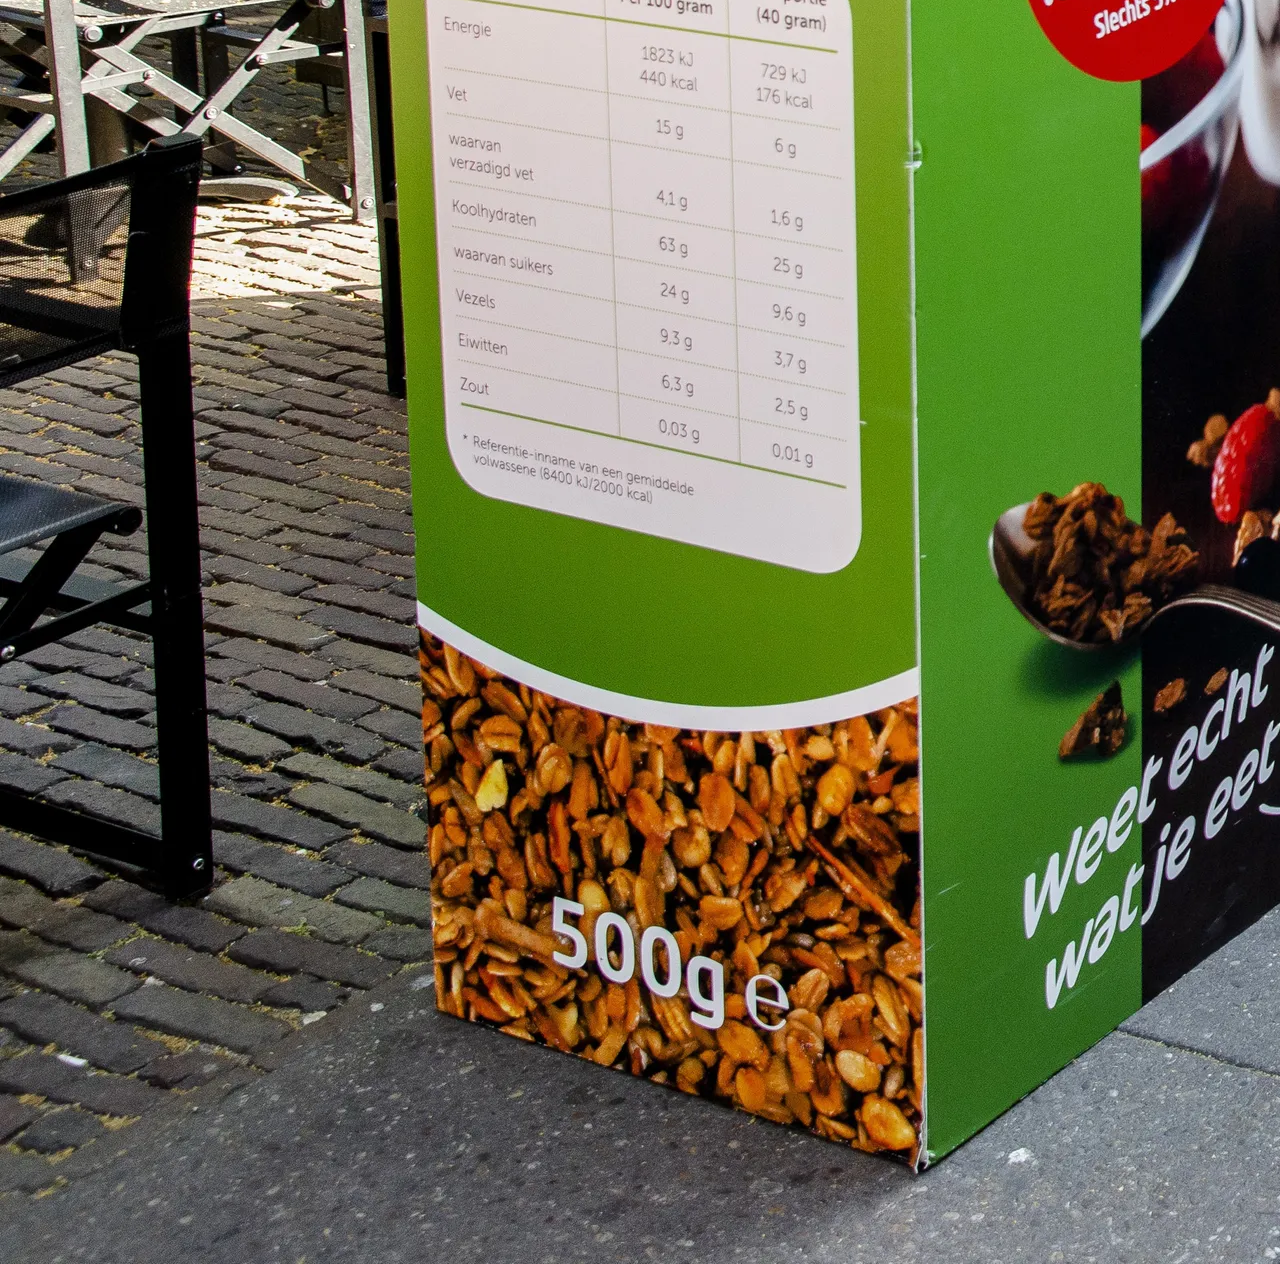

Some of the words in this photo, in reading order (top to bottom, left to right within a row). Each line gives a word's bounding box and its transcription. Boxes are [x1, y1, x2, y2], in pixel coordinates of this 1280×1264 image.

[444, 17, 492, 38] Energie
[756, 7, 780, 26] (40
[784, 12, 827, 33] gram)
[641, 46, 675, 65] 1823
[677, 50, 694, 67] kJ
[639, 70, 667, 87] 440
[670, 74, 698, 92] kcal
[760, 63, 787, 81] 729
[791, 67, 807, 85] kJ
[446, 85, 467, 102] Vet
[756, 87, 781, 105] 176
[785, 91, 814, 110] kcal
[656, 119, 672, 135] 15
[675, 124, 684, 140] g
[449, 134, 501, 154] waarvan
[774, 139, 784, 154] 6
[788, 142, 797, 158] g
[449, 156, 511, 180] verzadigd
[515, 166, 534, 182] vet
[656, 190, 675, 207] 4,1
[678, 194, 688, 211] g
[452, 199, 537, 228] Koolhydraten
[771, 209, 791, 228] 1,6
[794, 214, 804, 231] g
[659, 237, 677, 253] 63
[680, 241, 689, 258] g
[454, 246, 507, 267] waarvan
[510, 255, 554, 276] suikers
[773, 257, 792, 274] 25
[794, 263, 804, 279] g
[455, 288, 496, 310] Vezels
[660, 283, 678, 300] 24
[681, 288, 690, 305] g
[772, 304, 794, 323] 9,6
[797, 310, 806, 327] g
[458, 333, 508, 357] Eiwitten
[660, 328, 680, 347] 9,3
[684, 335, 693, 351] g
[774, 351, 794, 370] 3,7
[797, 357, 807, 373] g
[460, 377, 489, 397] Zout
[662, 375, 683, 393] 6,3
[685, 381, 695, 397] g
[775, 398, 795, 417] 2,5
[799, 403, 808, 420] g
[659, 419, 688, 439] 0,03
[691, 427, 701, 444] g
[473, 436, 576, 472] Referentie-inname
[579, 460, 599, 475] van
[602, 465, 623, 480] een
[626, 469, 694, 496] gemiddelde
[772, 444, 802, 463] 0,01
[804, 451, 814, 468] g
[473, 455, 536, 478] volwassene
[539, 465, 573, 488] (8400
[576, 473, 624, 498] kJ/2000
[627, 481, 654, 505] kcal)
[1168, 643, 1274, 790] echt
[1045, 863, 1145, 1009] wat
[1141, 823, 1196, 925] je
[1204, 720, 1280, 840] eet
[552, 895, 725, 1030] 500g
